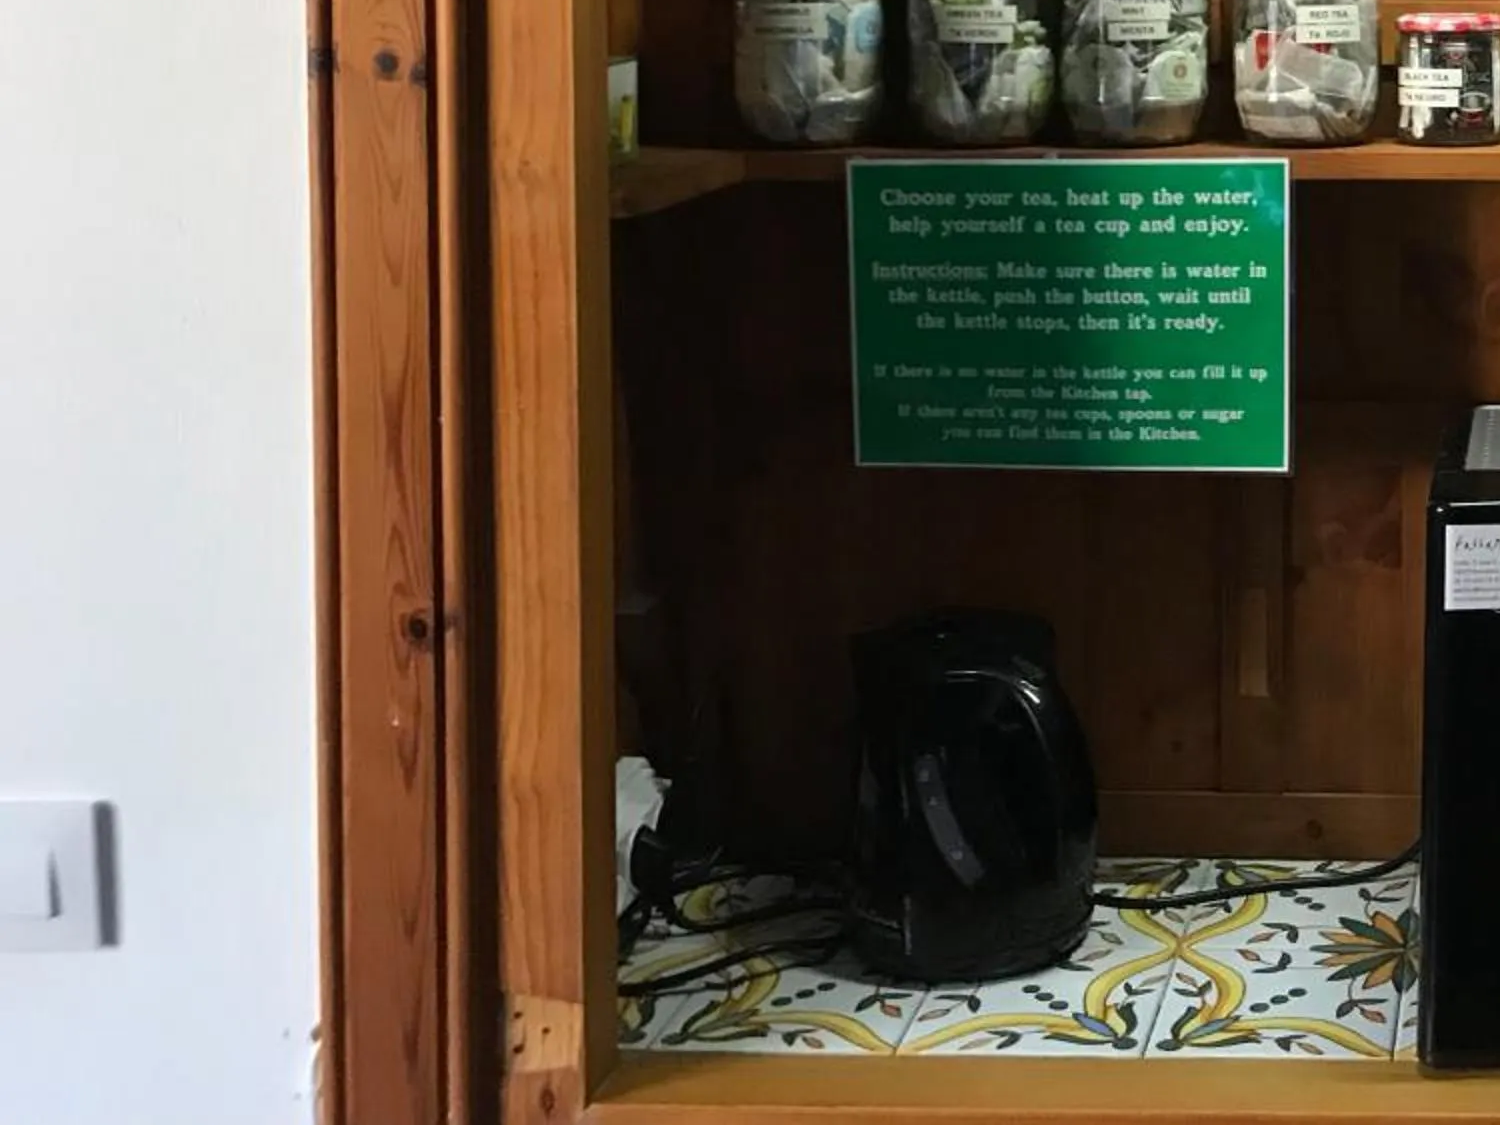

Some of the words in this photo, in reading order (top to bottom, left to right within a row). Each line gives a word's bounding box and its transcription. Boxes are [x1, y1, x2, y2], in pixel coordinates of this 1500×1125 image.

[964, 192, 1013, 209] your
[1066, 188, 1108, 205] heat
[1119, 192, 1143, 209] up
[1152, 187, 1184, 205] the
[889, 215, 931, 237] help
[941, 215, 1024, 236] yourself
[1034, 220, 1045, 232] a
[1055, 218, 1084, 233] tea
[1094, 220, 1129, 237] cup
[1139, 215, 1175, 232] and
[1183, 214, 1248, 236] enjoy.
[1103, 262, 1153, 278] there
[1161, 261, 1176, 278] is
[1186, 263, 1240, 278] water
[1249, 260, 1266, 277] in
[1157, 287, 1198, 303] wait
[1208, 286, 1250, 303] until
[1078, 313, 1119, 330] then
[1128, 313, 1155, 329] it's
[1164, 313, 1224, 333] ready.
[1133, 368, 1162, 381] you
[1169, 368, 1195, 379] can
[1202, 365, 1224, 379] fill
[1231, 364, 1241, 378] it
[1249, 368, 1267, 382] up
